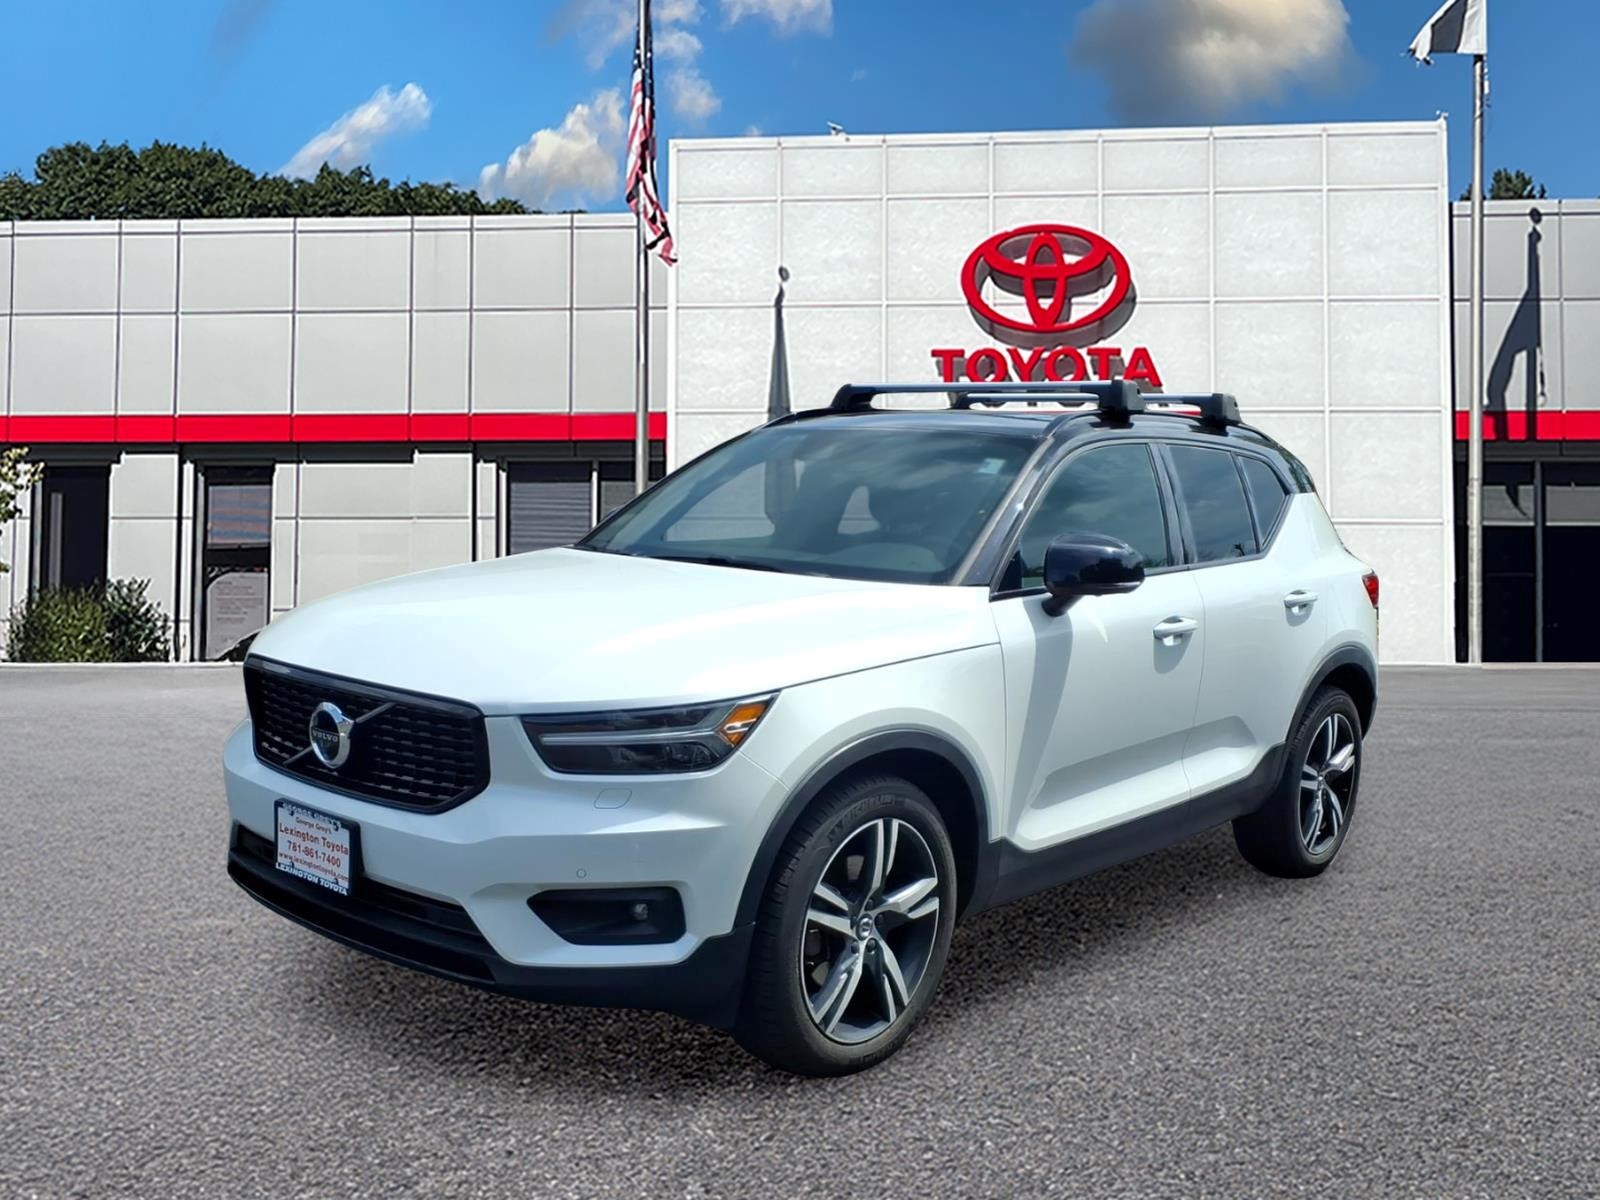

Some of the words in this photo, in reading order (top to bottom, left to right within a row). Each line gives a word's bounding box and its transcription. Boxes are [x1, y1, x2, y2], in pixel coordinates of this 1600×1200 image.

[931, 346, 1163, 388] TOYOTA
[312, 730, 338, 743] VOLVO
[279, 822, 320, 843] Lexington
[322, 836, 349, 855] Toyota
[287, 840, 341, 868] 781-861-7400
[320, 878, 348, 896] TOYOTA
